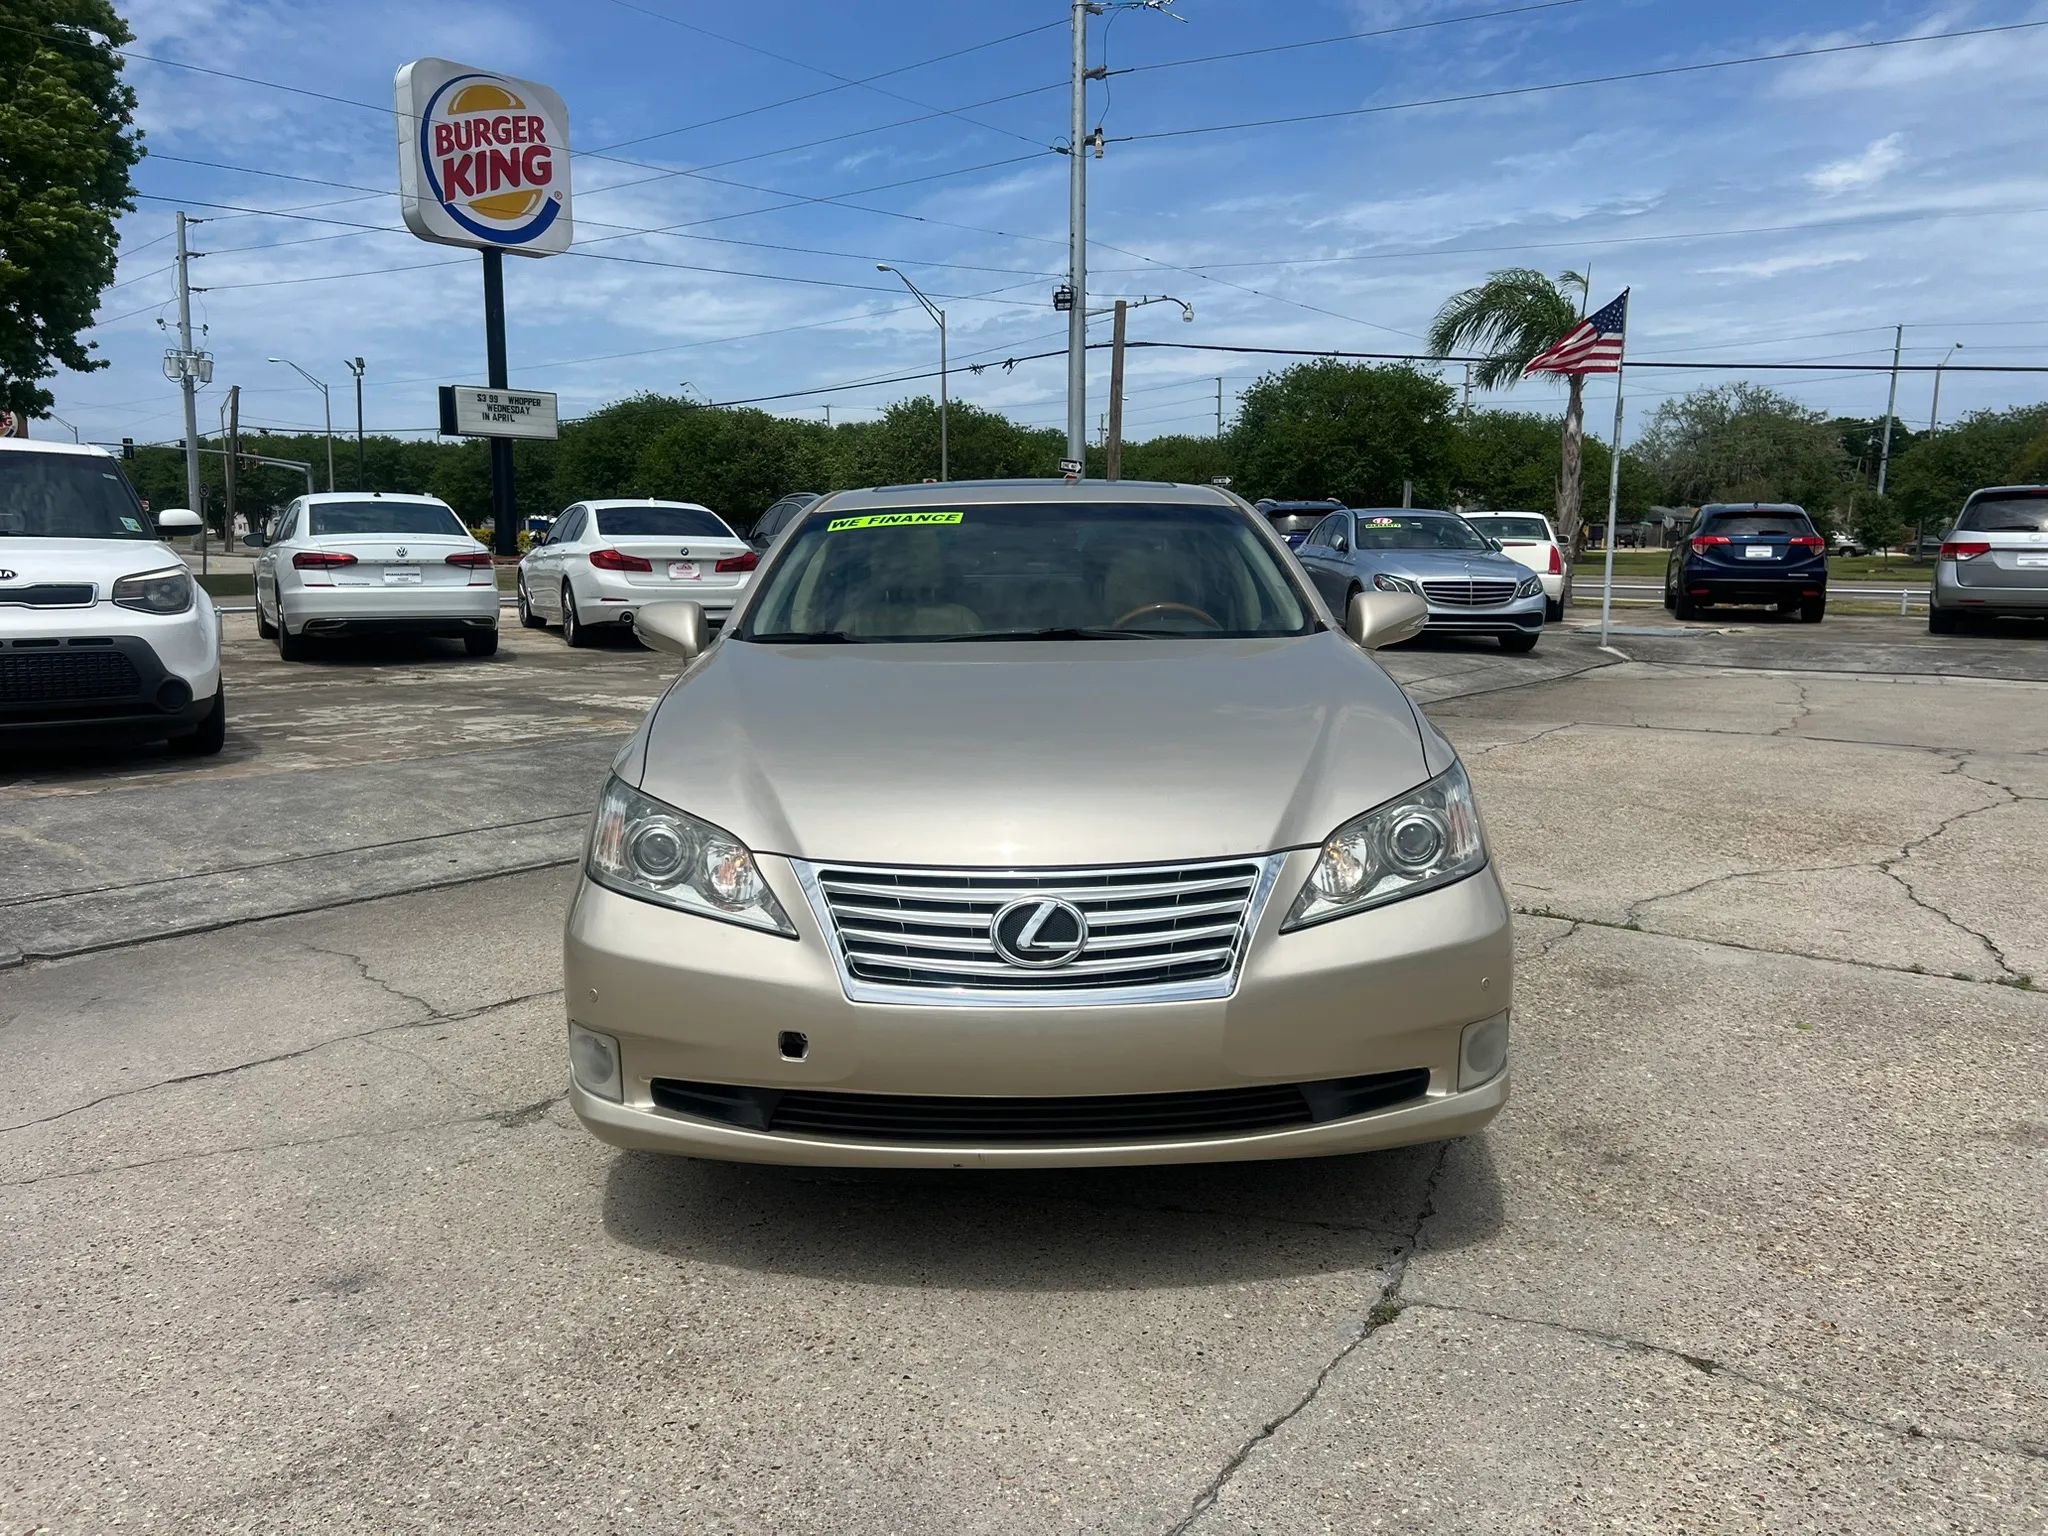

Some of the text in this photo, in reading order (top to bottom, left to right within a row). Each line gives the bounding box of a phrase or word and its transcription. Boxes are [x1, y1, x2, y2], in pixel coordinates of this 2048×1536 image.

[434, 115, 546, 157] BURGER
[443, 145, 553, 203] KING
[508, 396, 541, 407] WHOPPER
[487, 403, 530, 415] WEDNESDAY
[482, 412, 515, 423] IN APRIL
[831, 513, 960, 529] WE FINANCE
